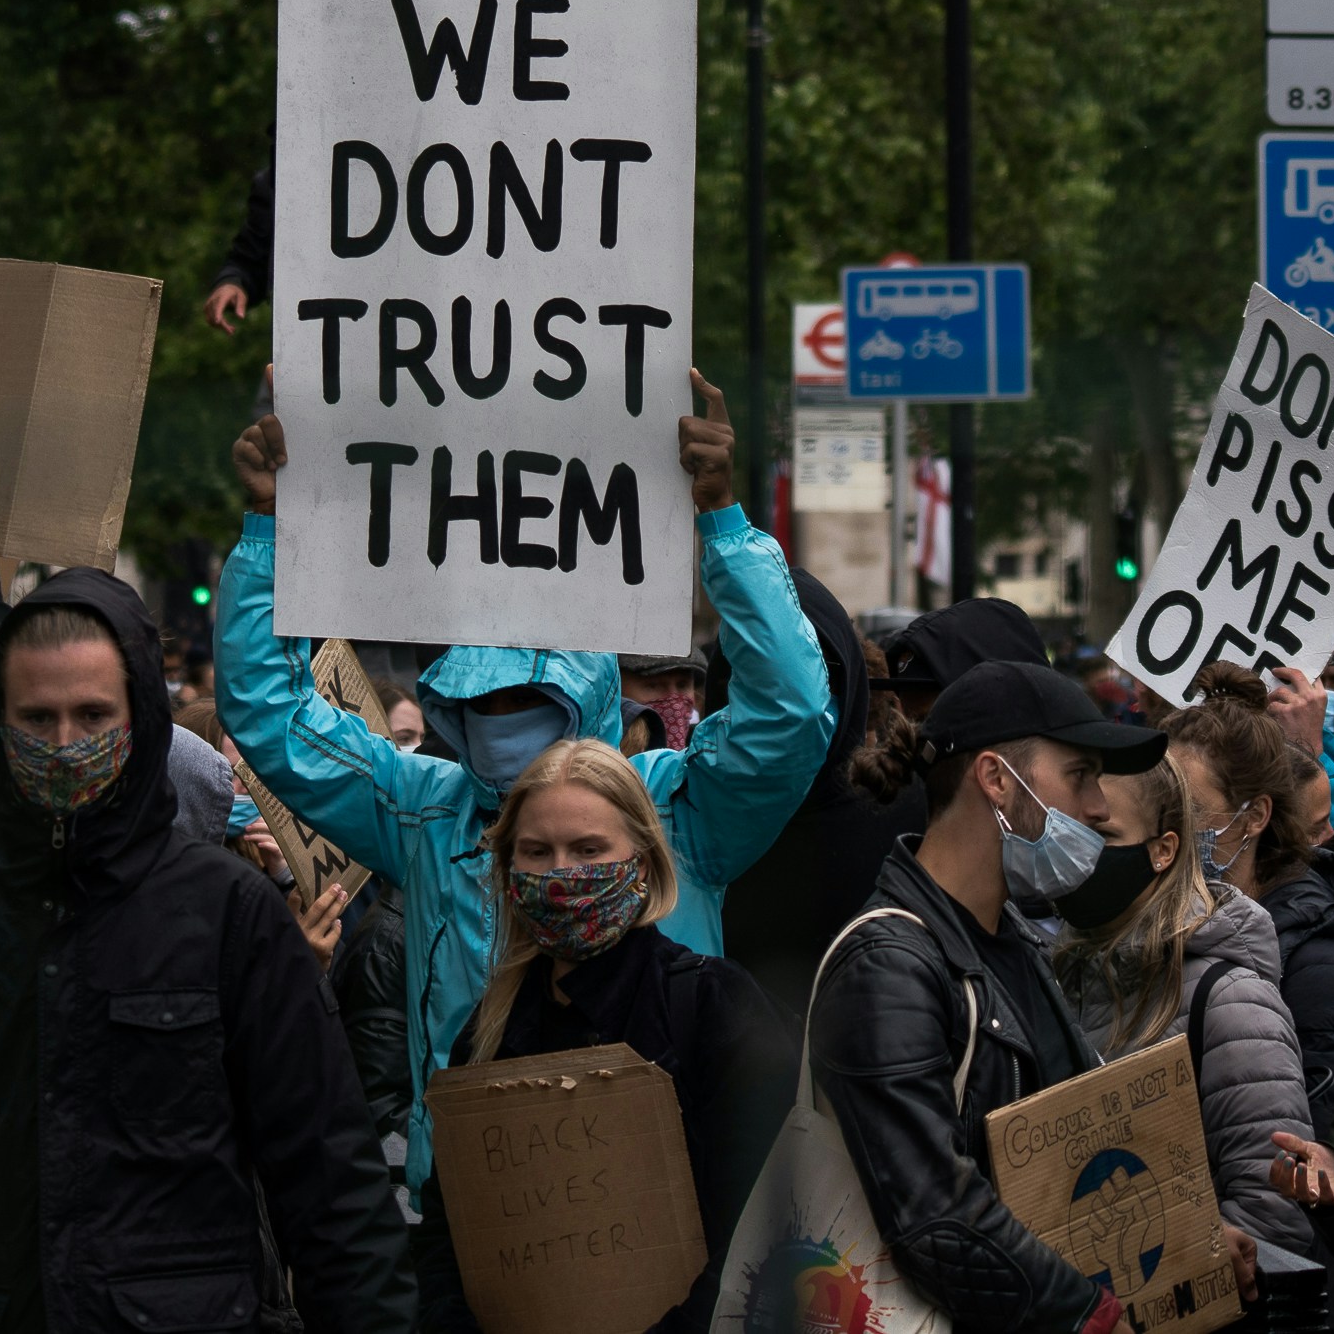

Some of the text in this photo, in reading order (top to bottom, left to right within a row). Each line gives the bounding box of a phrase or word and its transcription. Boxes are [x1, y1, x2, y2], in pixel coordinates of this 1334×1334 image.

[330, 138, 652, 260] DONT
[297, 295, 672, 418] TRUST
[345, 441, 645, 586] THEM
[1197, 519, 1331, 655] ME
[1101, 1090, 1123, 1117] IS
[1126, 1067, 1169, 1109] NOT
[1175, 1058, 1191, 1087] A
[482, 1113, 609, 1173] BLACK
[1064, 1114, 1134, 1170] CRIME
[500, 1168, 609, 1218] LIVES
